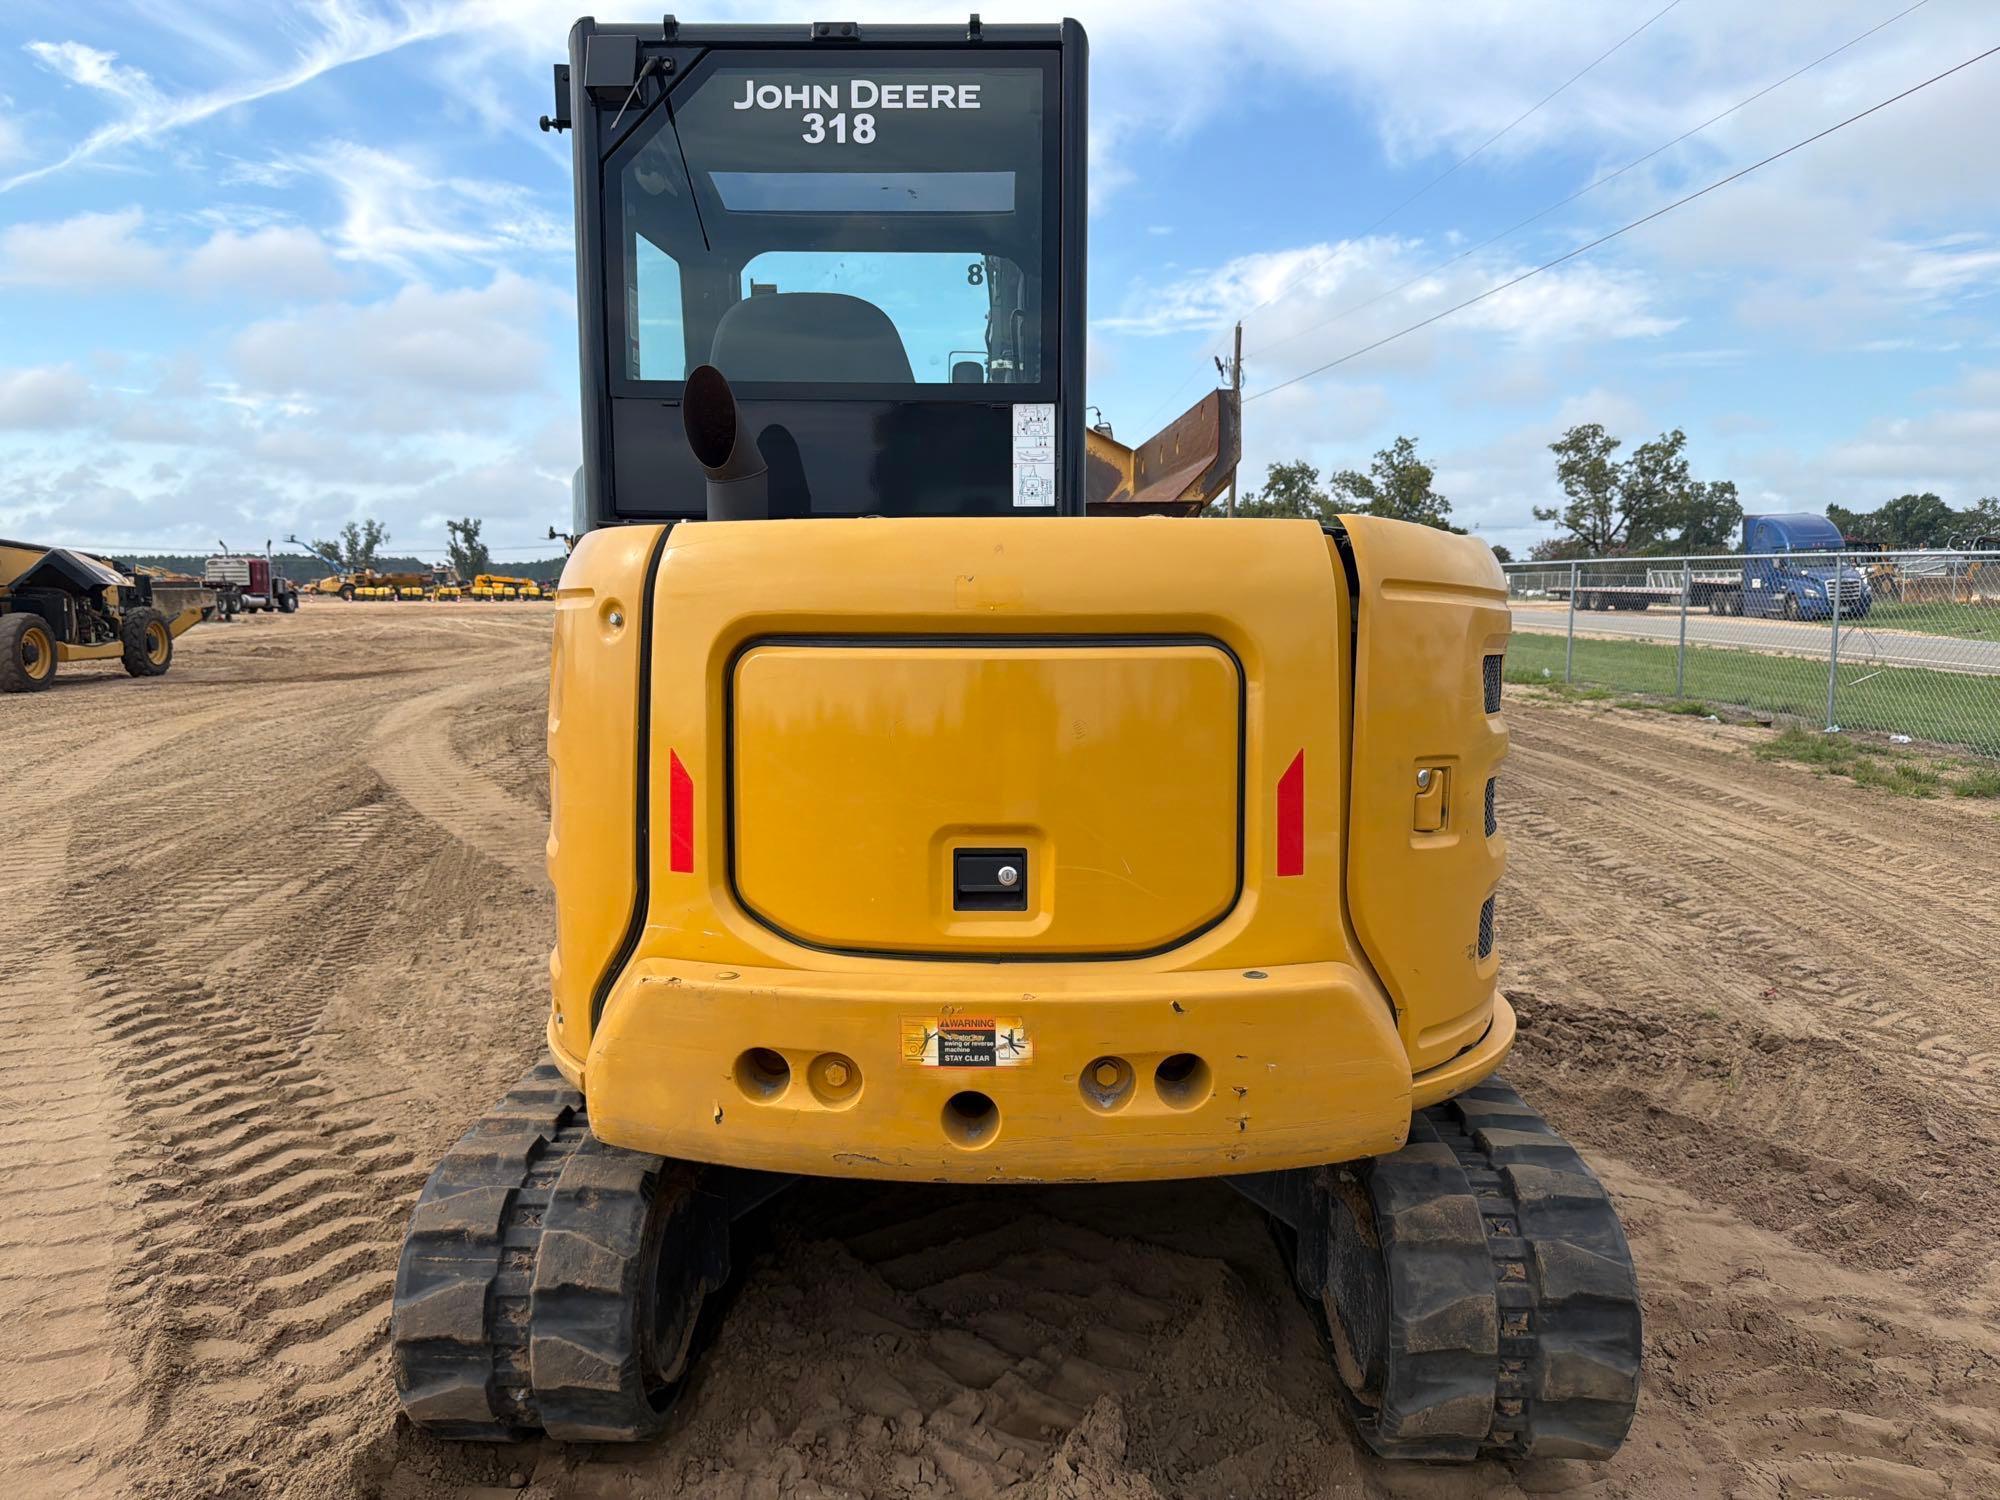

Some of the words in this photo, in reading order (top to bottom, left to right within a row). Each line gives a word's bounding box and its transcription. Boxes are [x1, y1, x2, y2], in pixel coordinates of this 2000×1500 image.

[733, 80, 838, 109] JOHN
[851, 80, 981, 109] DEERE
[802, 113, 876, 144] 318
[968, 264, 983, 285] 8
